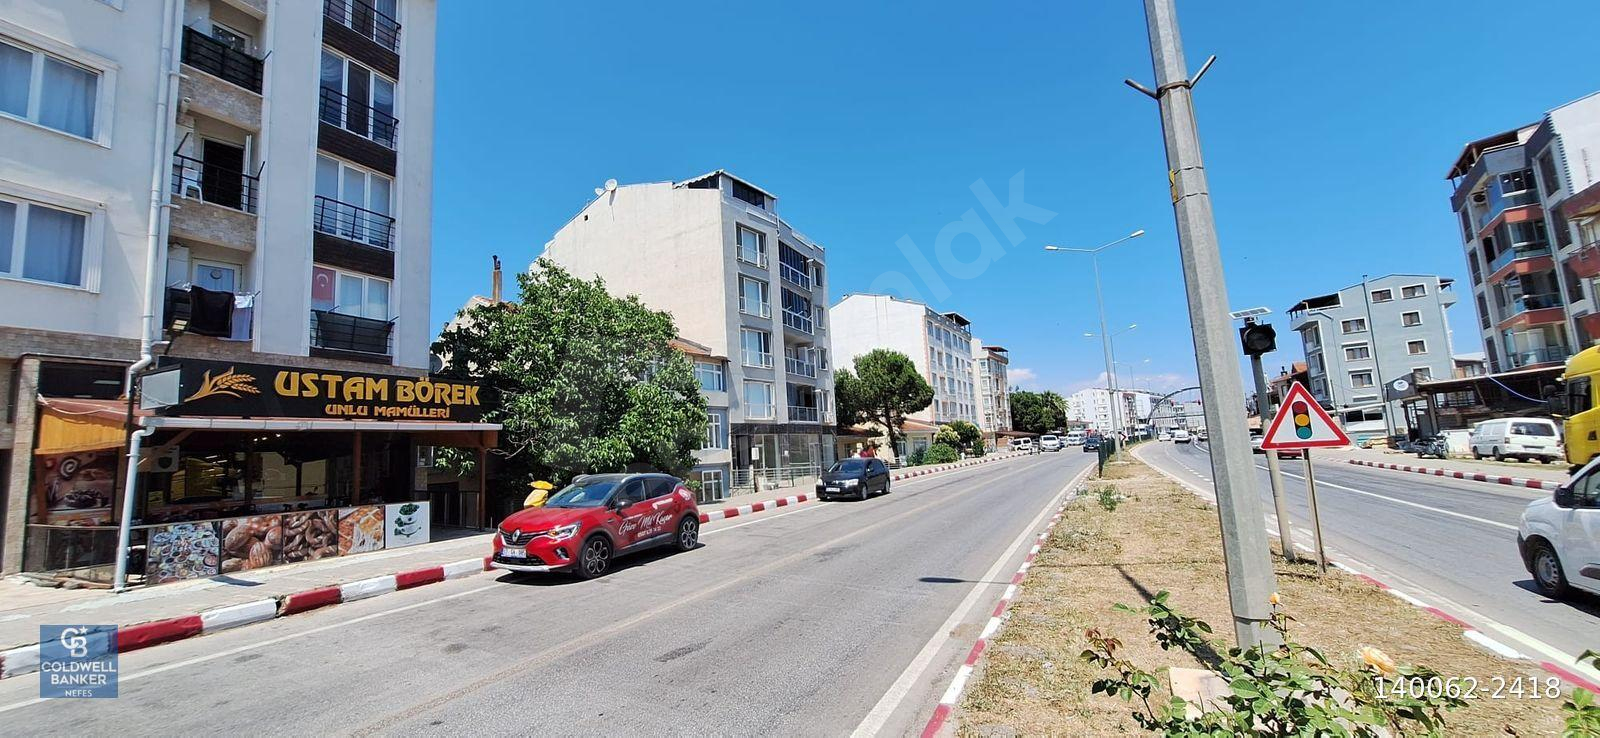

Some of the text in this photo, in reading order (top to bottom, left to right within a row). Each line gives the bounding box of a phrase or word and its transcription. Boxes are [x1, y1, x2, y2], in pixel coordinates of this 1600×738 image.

[274, 370, 481, 406] USTAM BÖREK
[325, 404, 450, 419] UNLU MAMÜLLERİ
